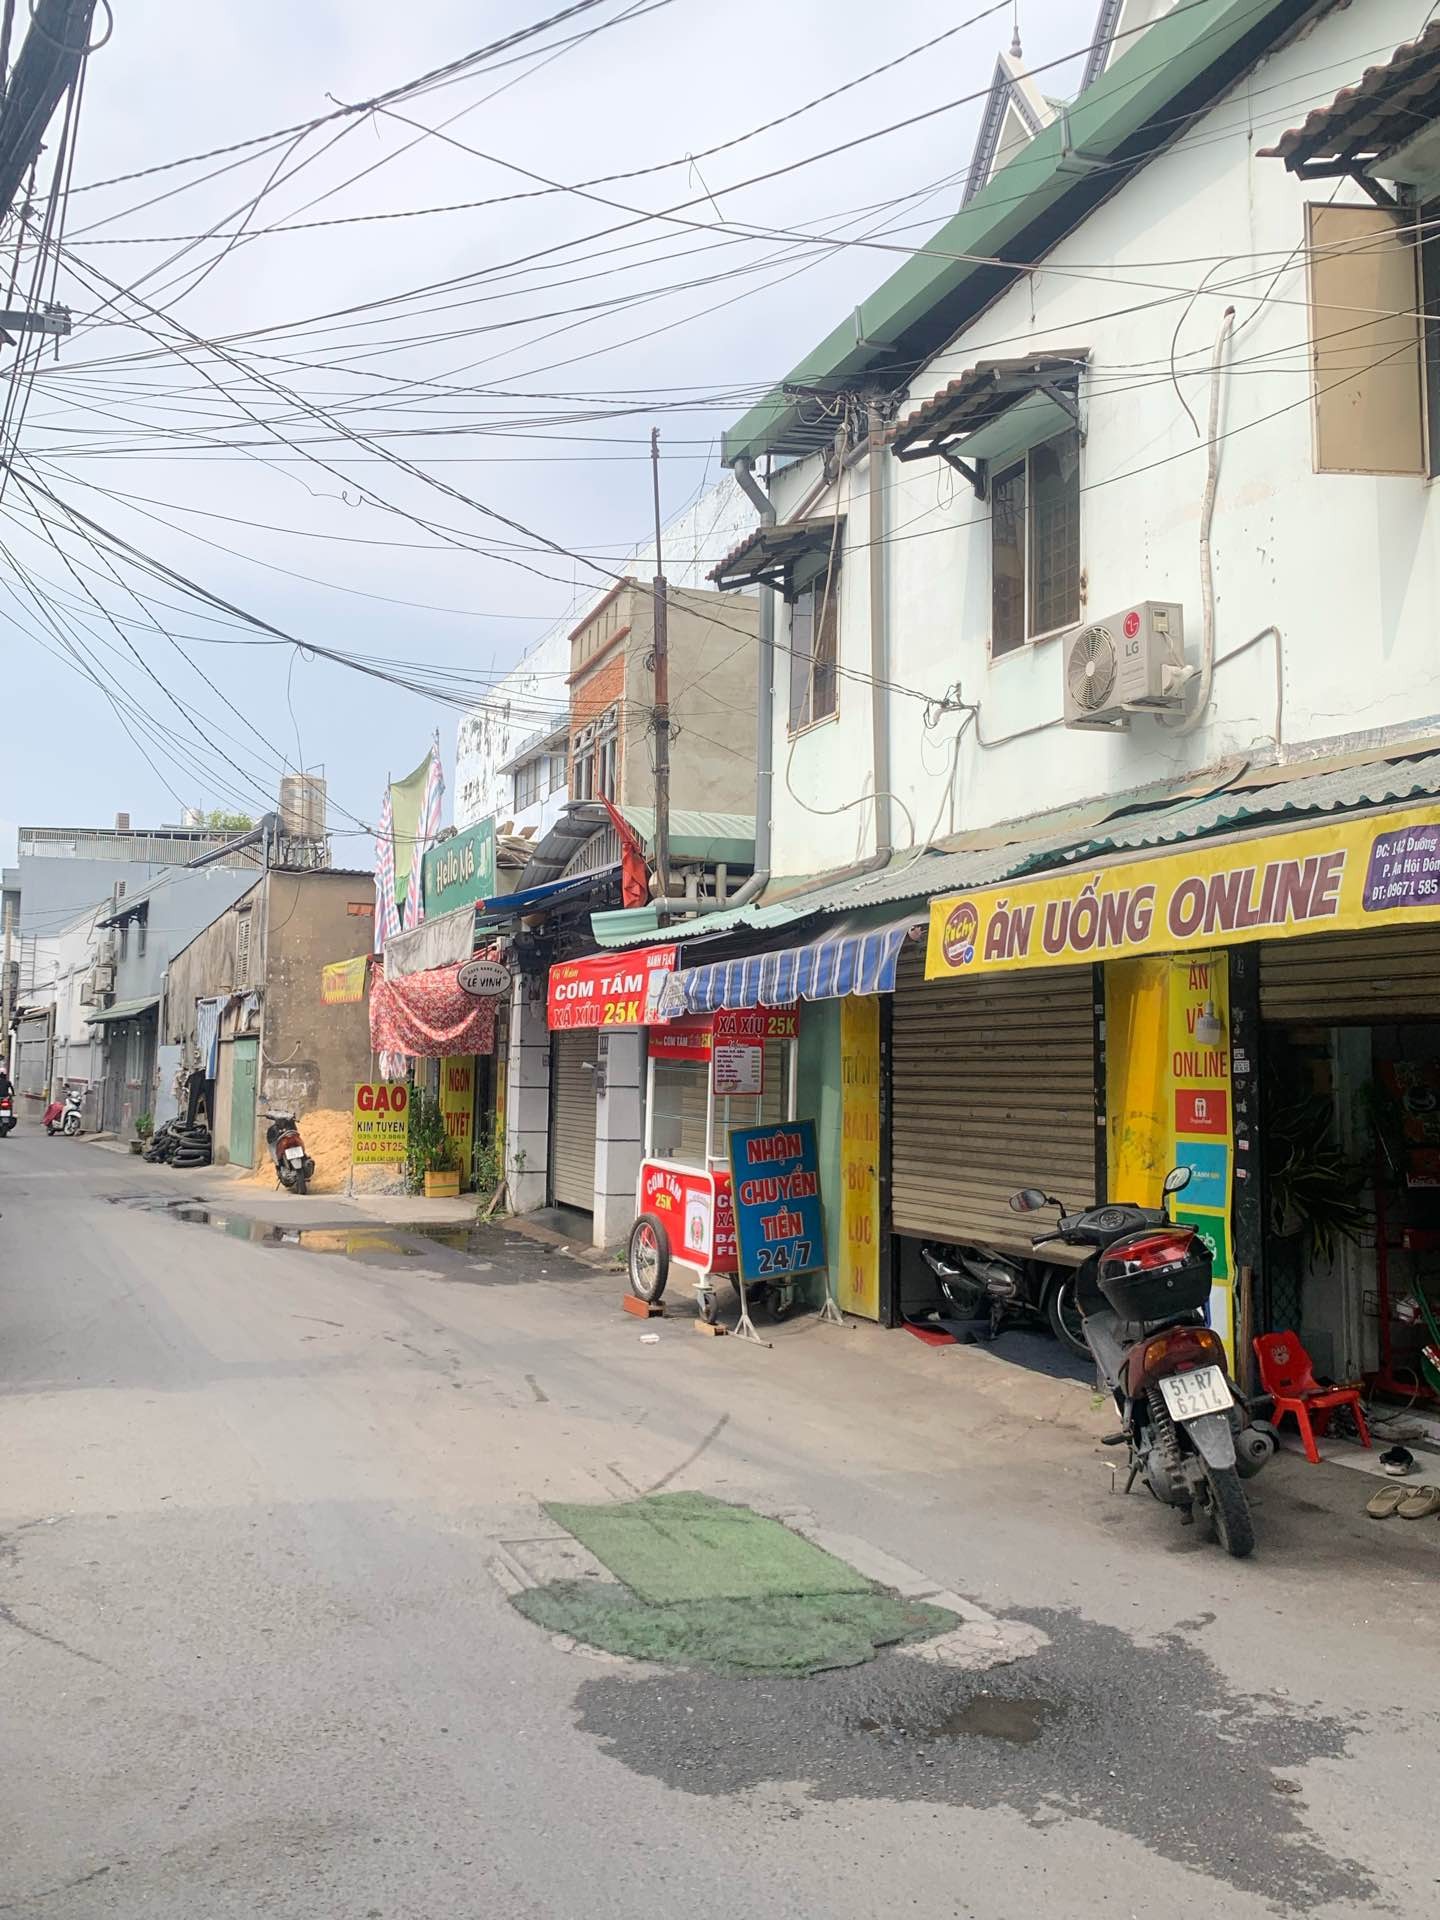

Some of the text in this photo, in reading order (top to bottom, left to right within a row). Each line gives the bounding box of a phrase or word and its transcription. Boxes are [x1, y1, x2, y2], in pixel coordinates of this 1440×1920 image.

[1125, 641, 1140, 657] LG
[436, 839, 475, 894] Hello Má
[1403, 858, 1420, 876] Hội
[1422, 857, 1440, 872] Đôn
[1418, 879, 1438, 895] 585
[984, 849, 1347, 961] ĂN UỐNG ONLINE
[467, 974, 502, 988] LÊ VINH
[555, 970, 643, 1001] CƠM TẤM
[1188, 959, 1208, 990] ĂN
[554, 1002, 572, 1028] XÁ
[603, 1000, 640, 1024] 25K
[718, 1012, 796, 1034] XÁ XÍU 25K
[1172, 1051, 1228, 1078] ONLINE
[448, 1067, 471, 1092] NGON
[357, 1084, 407, 1119] GẠO
[357, 1121, 373, 1132] KIM
[380, 1141, 404, 1152] ST25
[746, 1129, 803, 1166] NHẬN
[739, 1163, 818, 1206] CHUYỂN
[655, 1193, 672, 1211] 25K
[760, 1205, 804, 1242] TIỀN
[715, 1231, 737, 1243] BÁ
[716, 1246, 737, 1256] FL
[757, 1240, 812, 1274] 24/7
